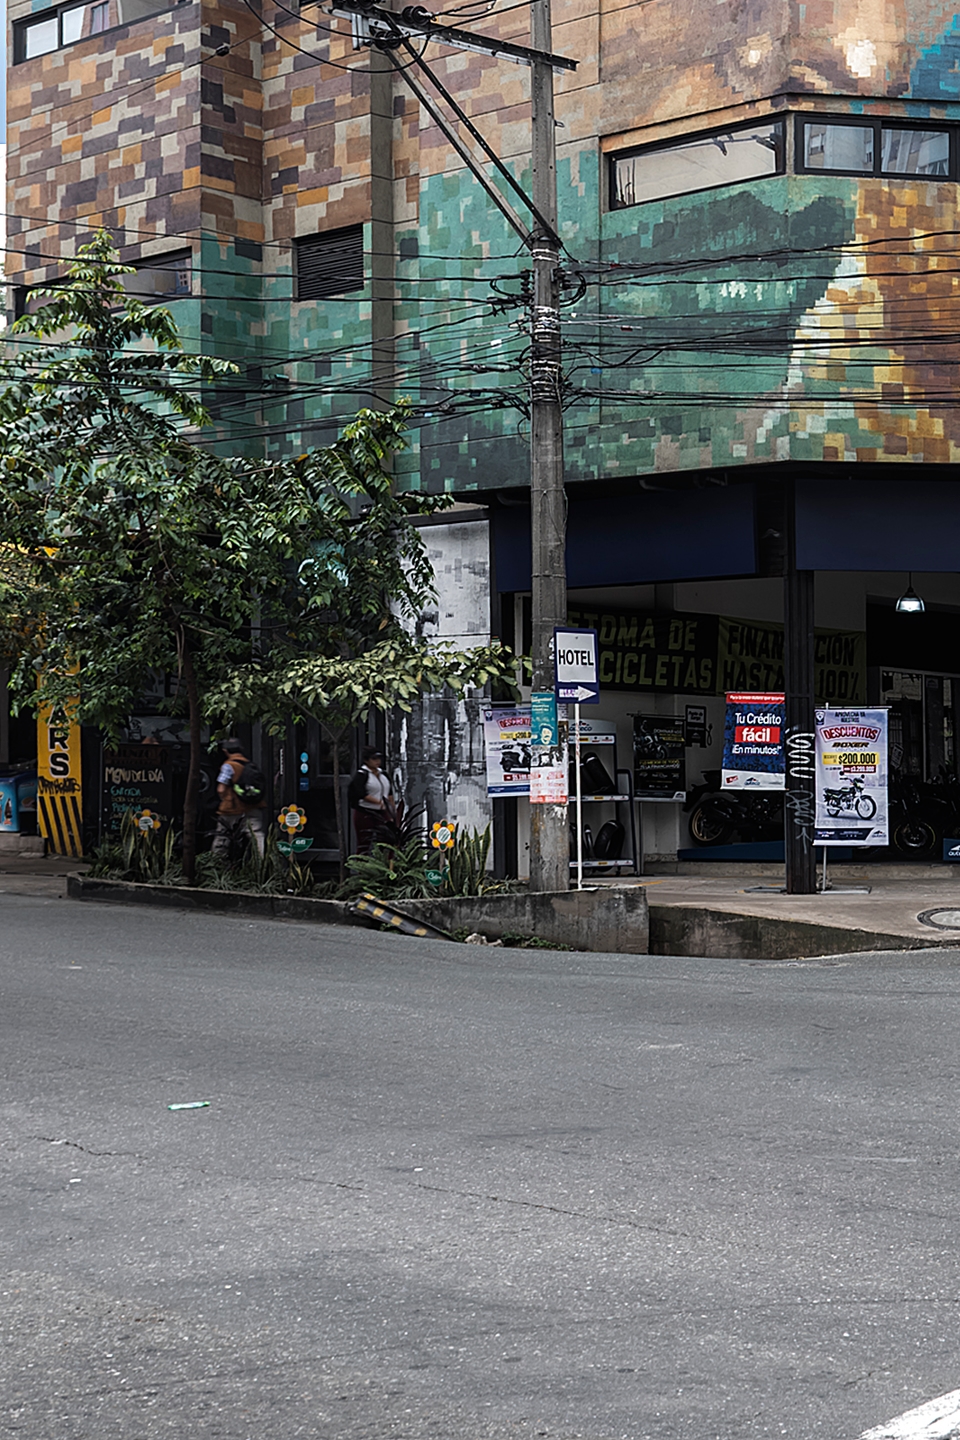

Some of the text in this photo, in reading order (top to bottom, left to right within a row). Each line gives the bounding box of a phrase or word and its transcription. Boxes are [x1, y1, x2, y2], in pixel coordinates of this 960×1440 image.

[567, 611, 698, 652] ETOMA DE
[728, 625, 855, 666] FINANCIÓN
[558, 649, 594, 666] HOTEL
[723, 660, 859, 700] HASTA 100%
[735, 713, 782, 725] Tu Crédito
[742, 727, 771, 742] fácil
[824, 726, 878, 740] DESCUENTOS
